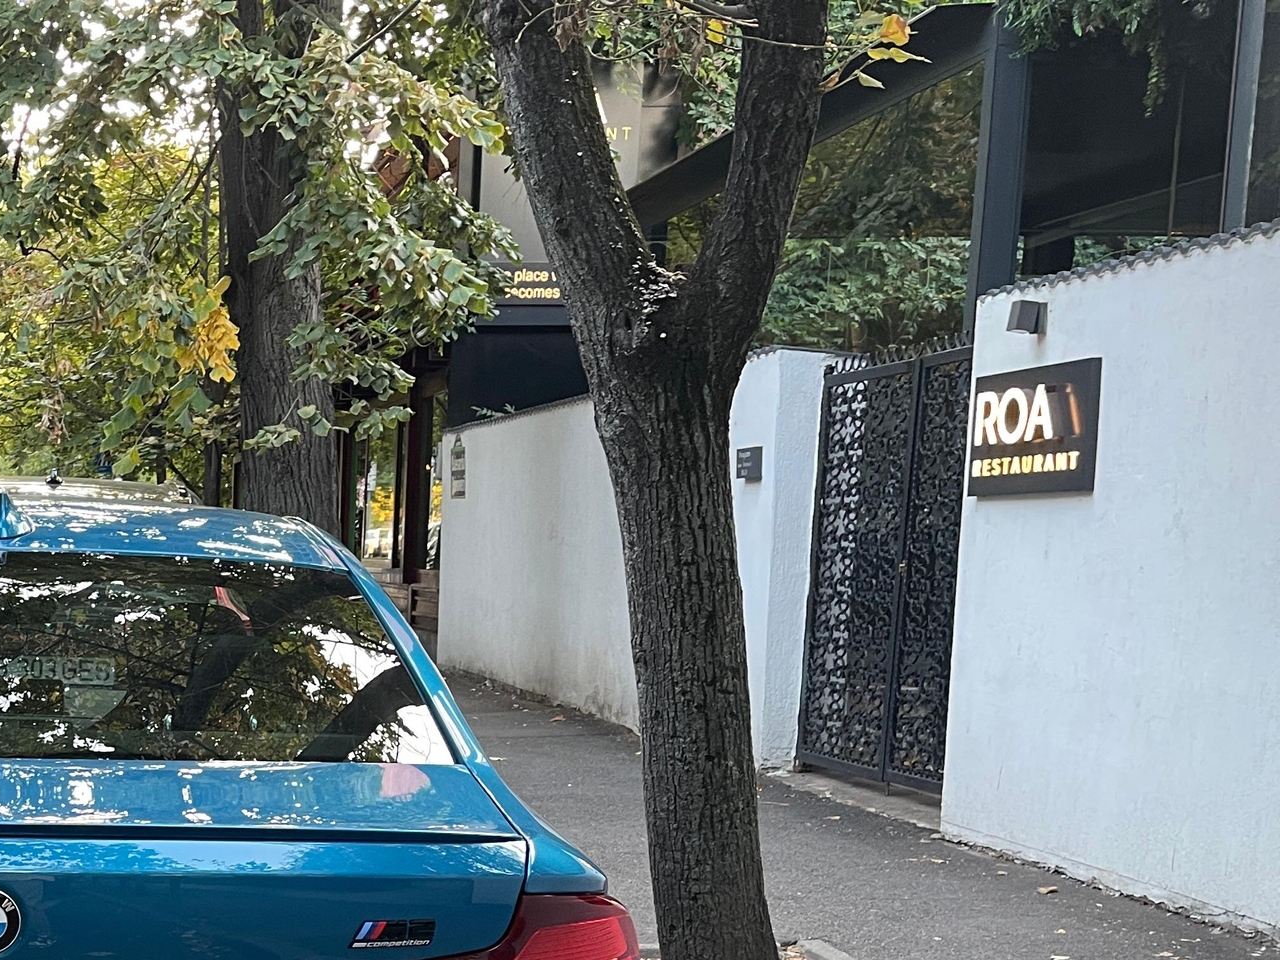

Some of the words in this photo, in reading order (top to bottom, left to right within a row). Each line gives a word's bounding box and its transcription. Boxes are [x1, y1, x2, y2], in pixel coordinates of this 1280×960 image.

[513, 268, 549, 285] place
[973, 383, 1053, 447] ROA
[971, 450, 1080, 477] RESTAURANT
[366, 939, 431, 948] competition
